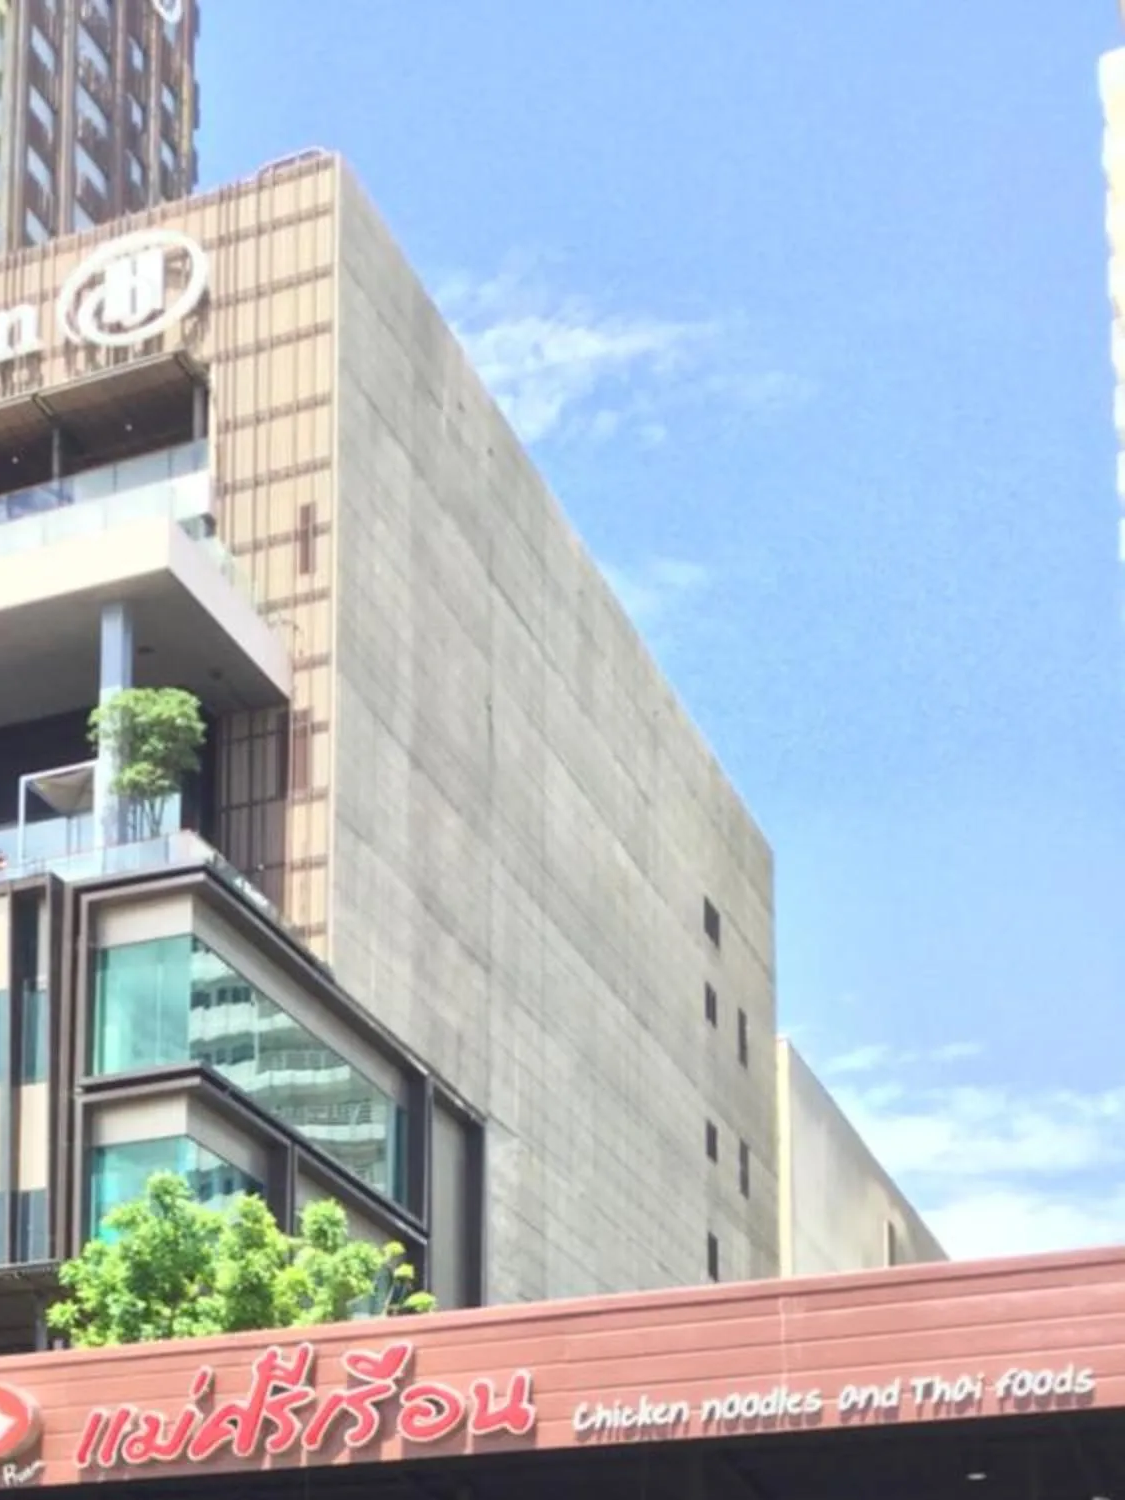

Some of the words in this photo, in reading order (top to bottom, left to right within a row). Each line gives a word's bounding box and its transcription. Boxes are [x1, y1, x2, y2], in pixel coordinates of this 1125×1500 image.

[573, 1394, 690, 1432] Chicken
[701, 1385, 822, 1423] noodles
[838, 1377, 900, 1412] and
[910, 1369, 983, 1405] Thai
[995, 1363, 1095, 1399] foods
